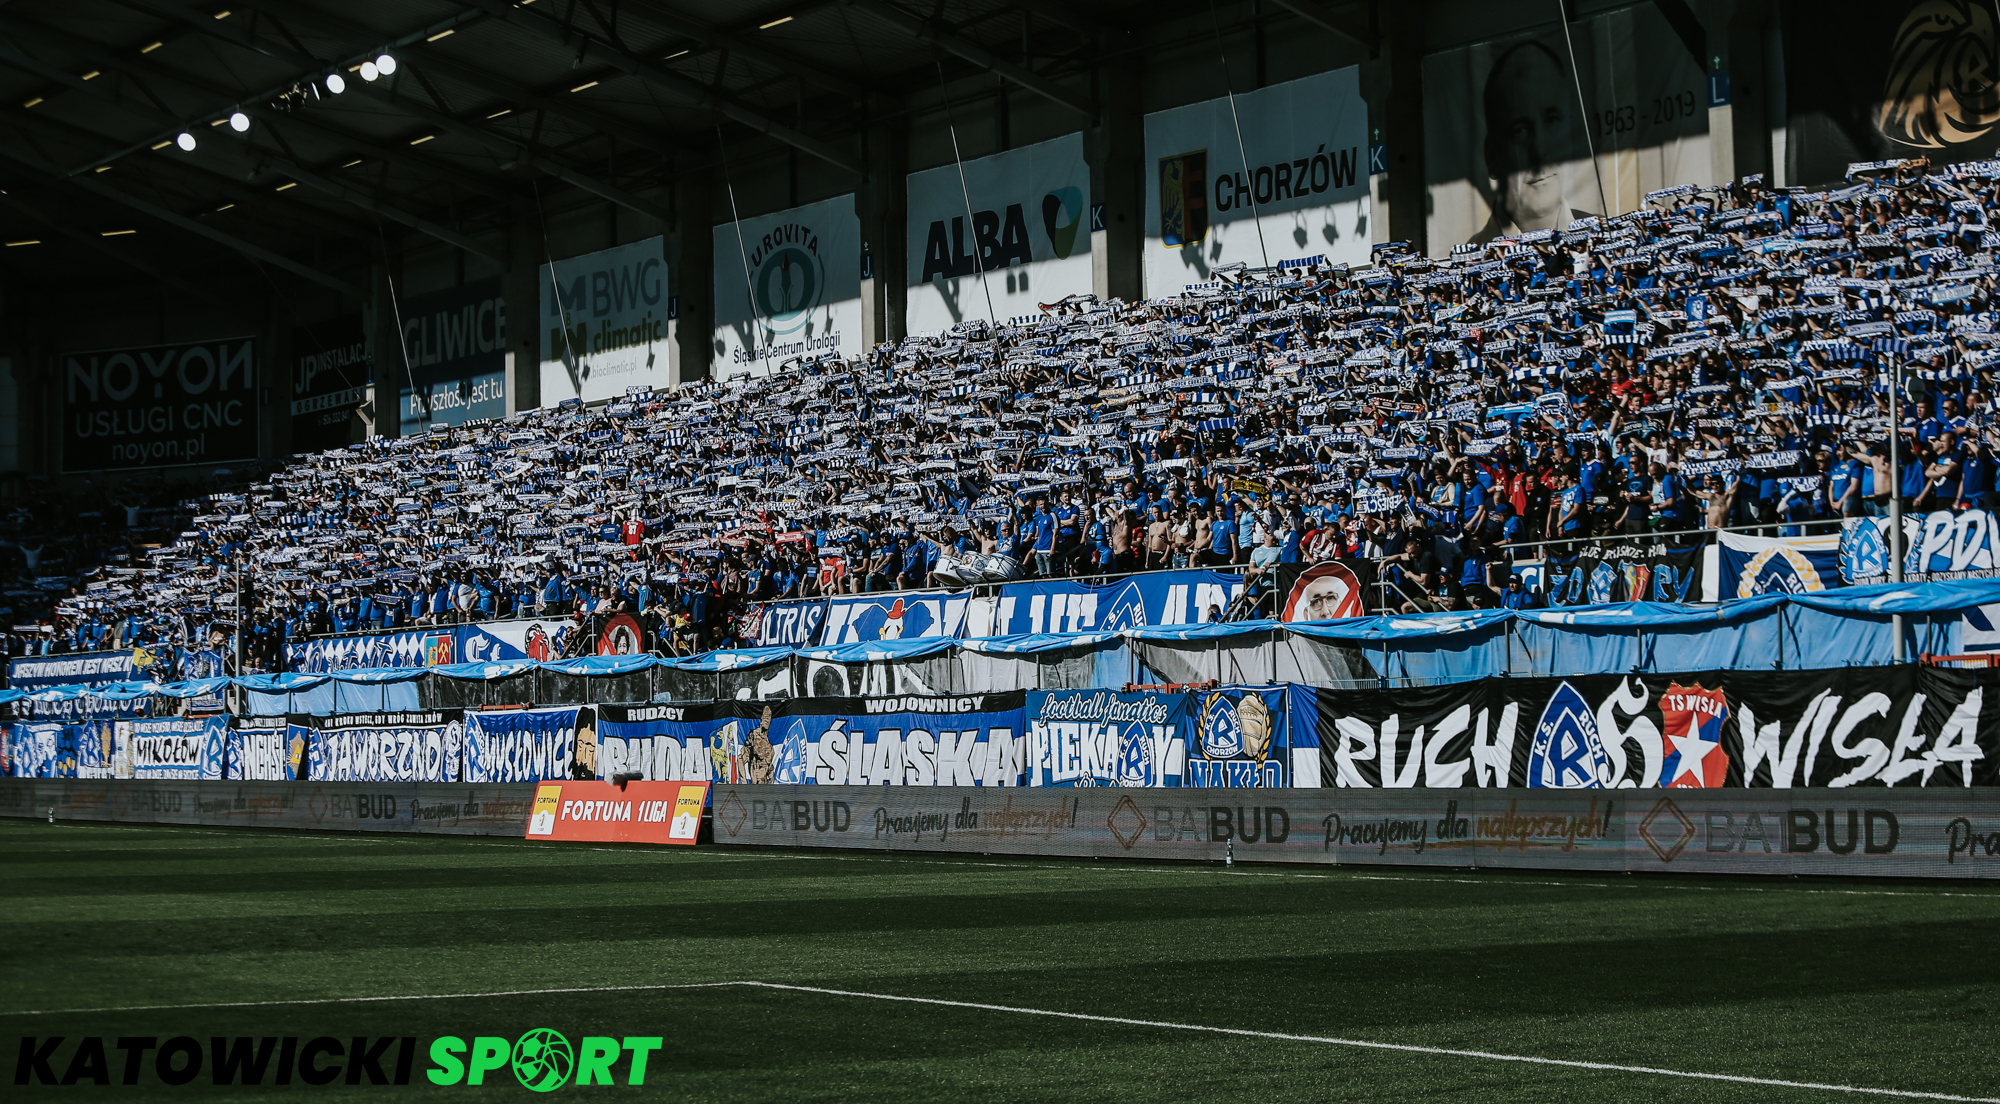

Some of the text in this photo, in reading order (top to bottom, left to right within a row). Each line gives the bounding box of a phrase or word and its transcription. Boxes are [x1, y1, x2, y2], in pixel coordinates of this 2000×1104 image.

[1593, 104, 1635, 137] 1963
[1652, 90, 1696, 127] 2019
[1214, 142, 1358, 213] CHORZÓW
[1370, 147, 1384, 172] K
[1092, 206, 1104, 229] K
[751, 223, 819, 268] UROVITA
[921, 202, 1033, 283] ALBA
[592, 257, 662, 318] BWG
[403, 297, 506, 370] GLIWICE
[593, 310, 662, 355] climatic
[733, 330, 841, 366] Śląskie Centrum Urologii
[67, 340, 253, 404] NOYON
[295, 355, 318, 395] JP
[466, 379, 489, 411] jest
[490, 377, 503, 400] tu
[75, 399, 244, 439] USŁUGI CNC
[112, 432, 205, 465] noyon.pl
[757, 604, 821, 647] ULTRAS
[387, 712, 405, 725] WRÓG
[864, 695, 985, 715] WOJOWNICY
[1039, 691, 1168, 728] football fanatics
[1228, 708, 1241, 735] RUCH
[1667, 694, 1724, 719] TS WISŁA
[136, 733, 200, 764] MIKOŁÓW
[1334, 701, 1519, 789] RUCH
[1577, 708, 1604, 760] RUCH
[1736, 685, 1986, 789] WISŁA
[1188, 759, 1283, 788] NAKŁO
[463, 790, 479, 817] dla
[560, 799, 632, 822] FORTUNA
[874, 805, 949, 843] Pracujemy
[955, 796, 978, 830] dla
[1322, 812, 1427, 856] Pracujemy
[1436, 799, 1468, 840] dla
